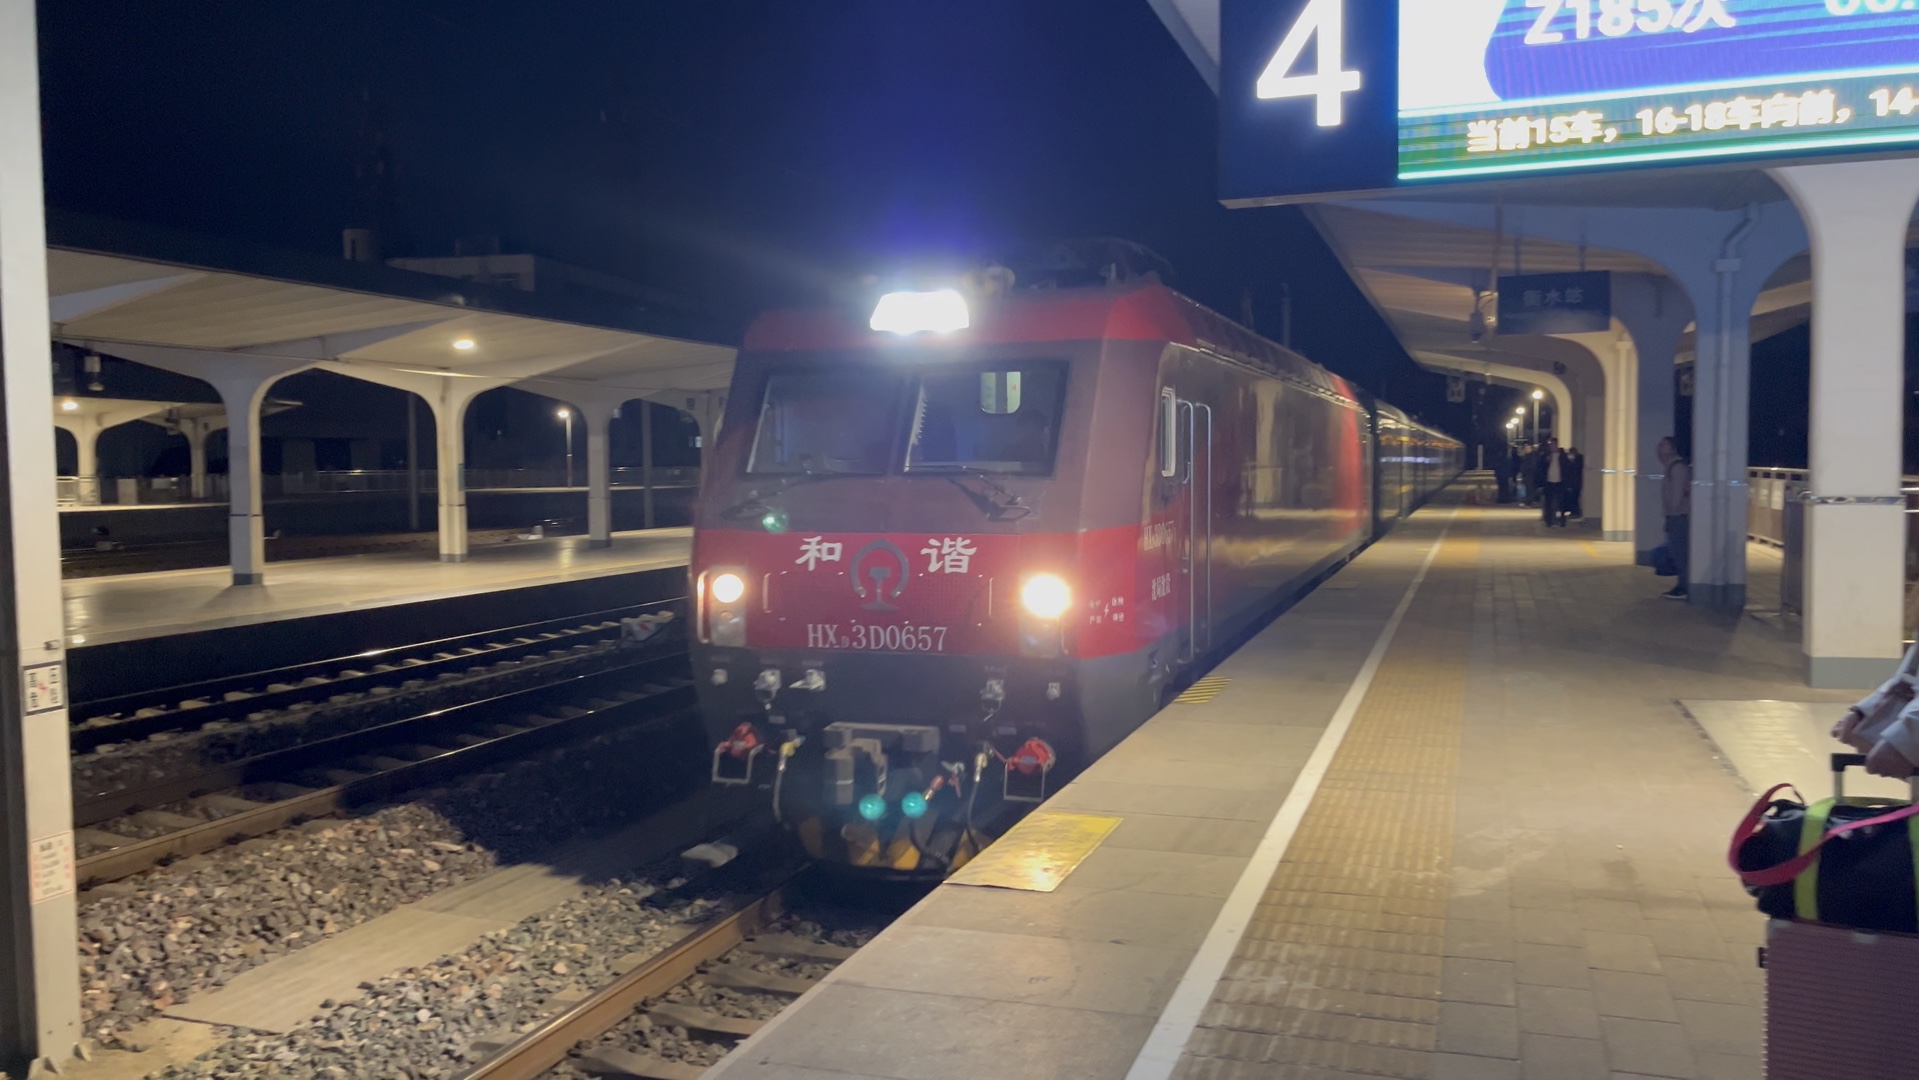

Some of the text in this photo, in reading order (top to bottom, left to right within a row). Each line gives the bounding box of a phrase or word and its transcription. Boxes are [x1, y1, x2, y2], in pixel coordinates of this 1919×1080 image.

[1523, 0, 1737, 45] Z185次
[1256, 0, 1361, 127] 4
[795, 535, 978, 574] 和 谐
